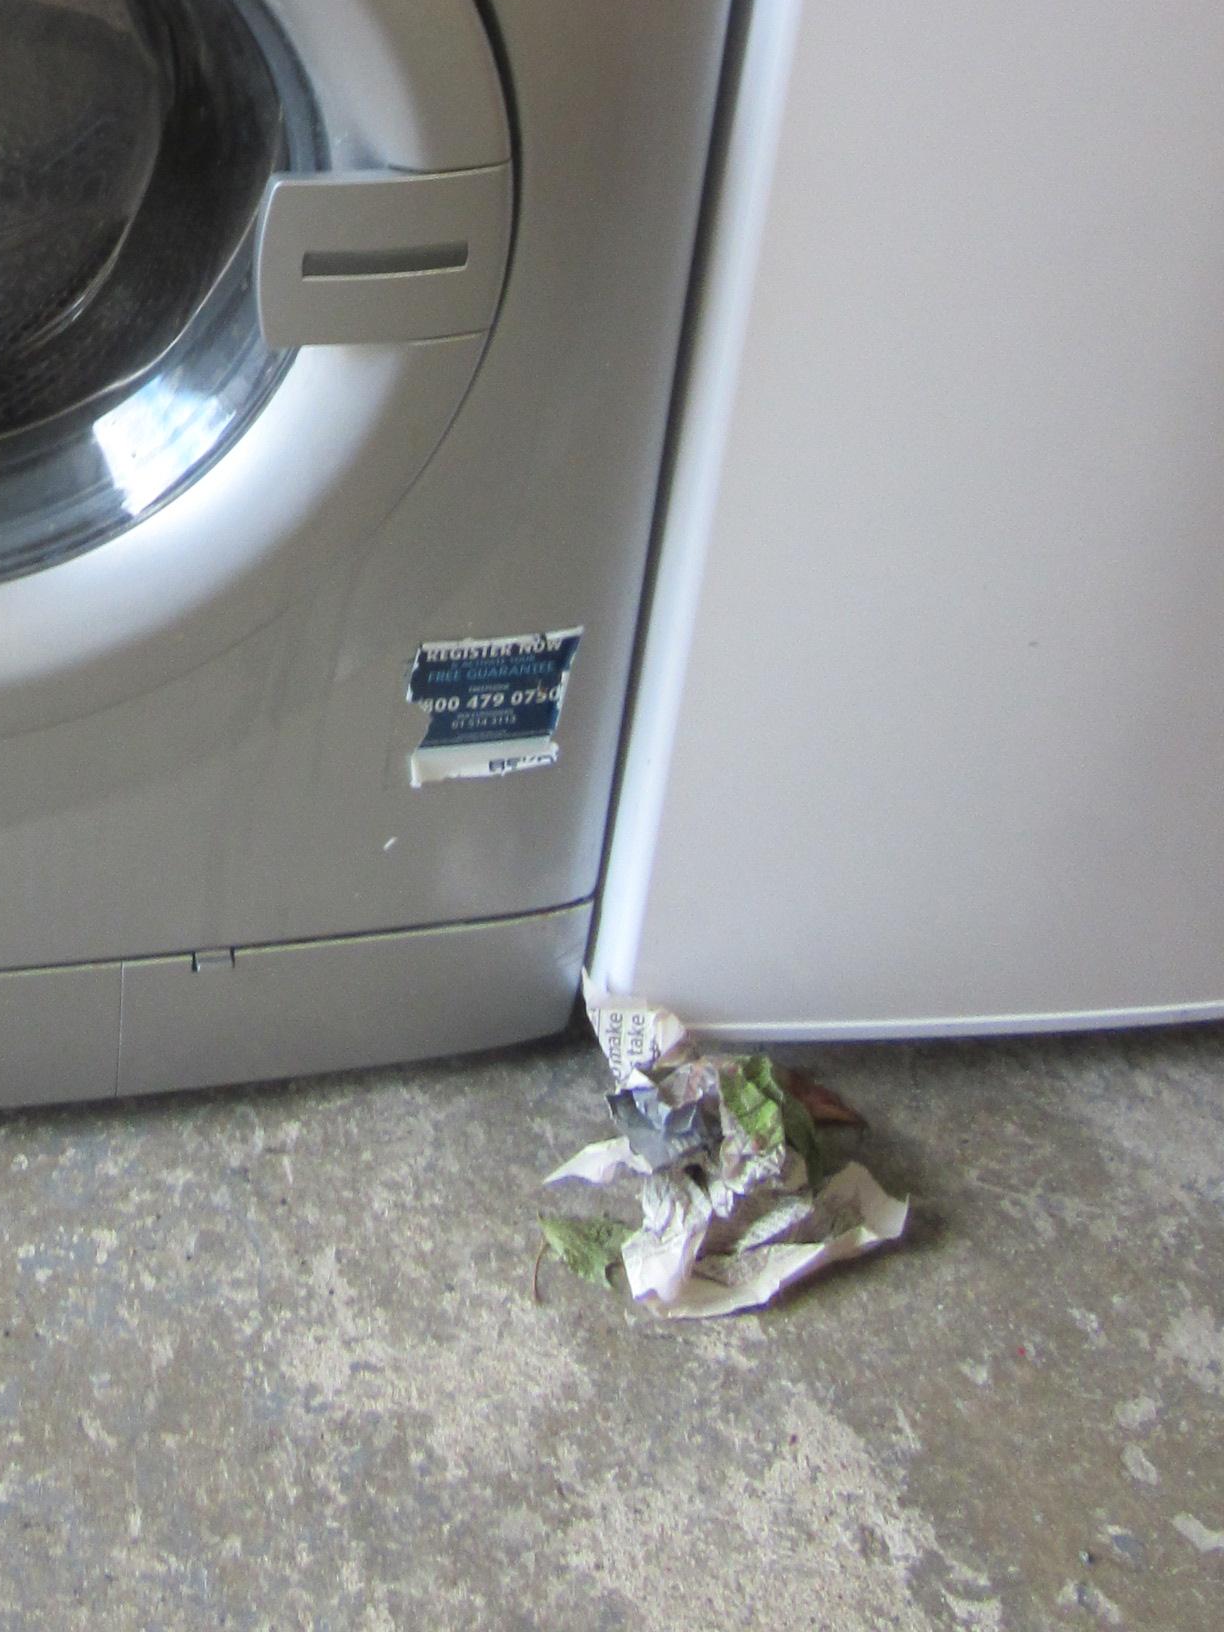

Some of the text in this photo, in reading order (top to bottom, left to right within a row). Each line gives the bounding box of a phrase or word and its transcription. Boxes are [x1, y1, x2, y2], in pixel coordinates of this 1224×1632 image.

[426, 643, 513, 663] REGISTER
[466, 693, 505, 710] 479
[627, 1013, 645, 1056] take
